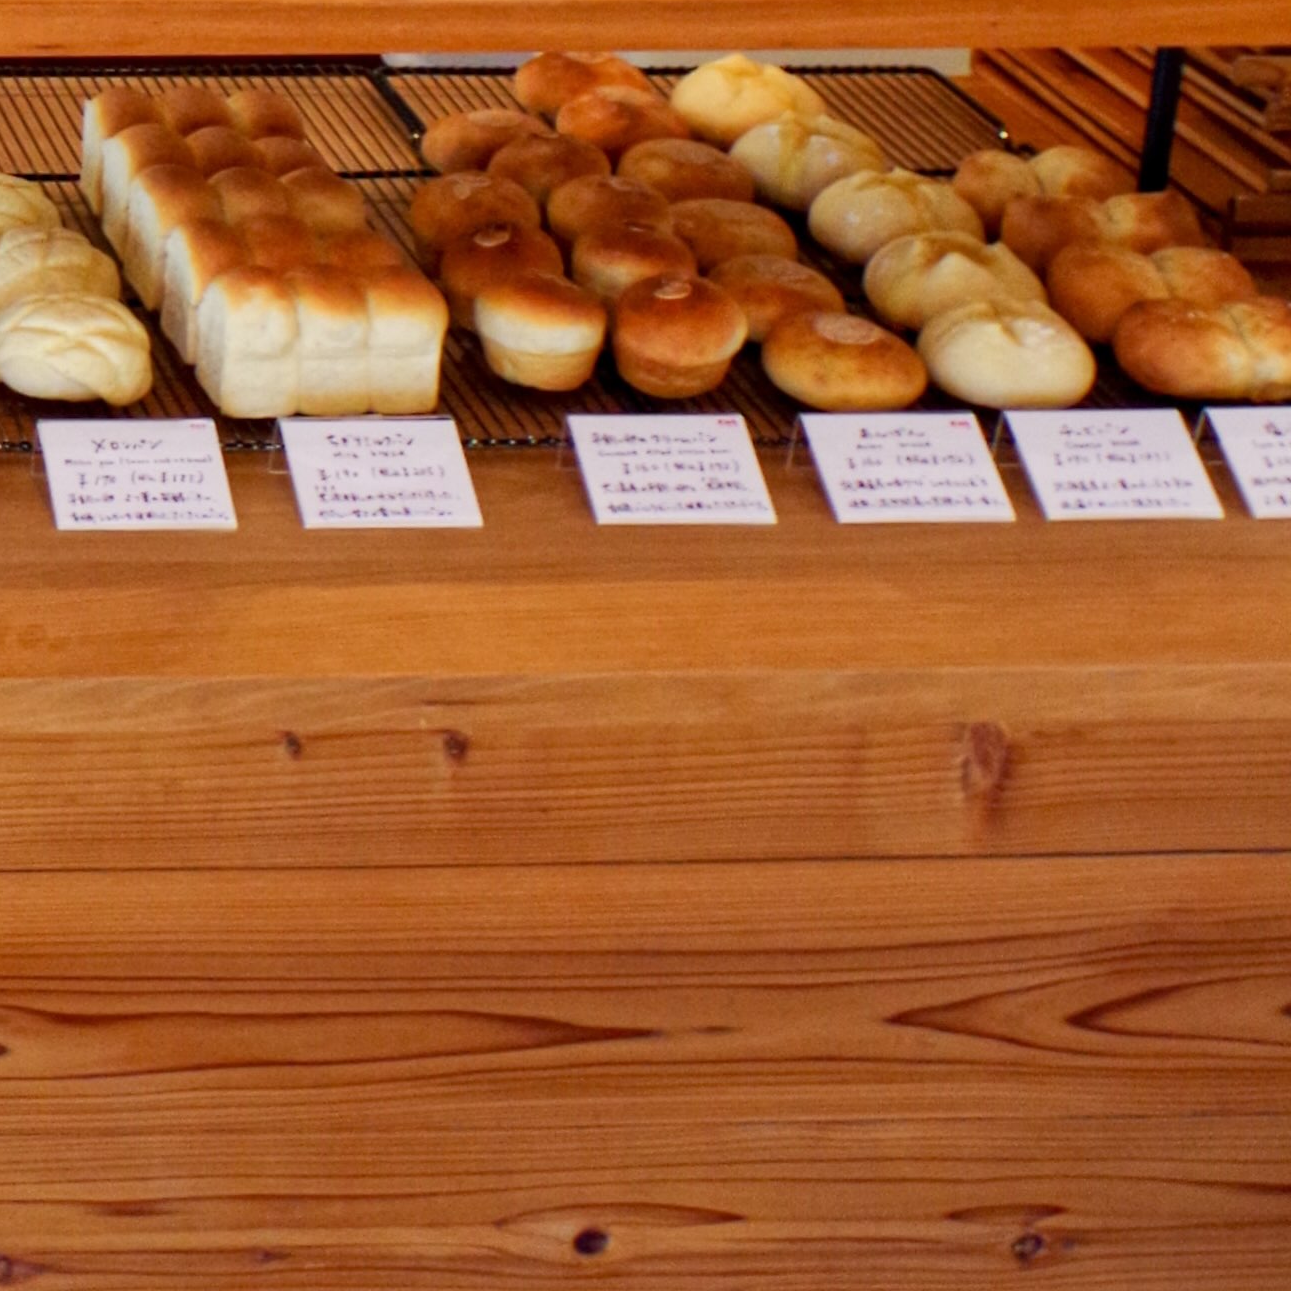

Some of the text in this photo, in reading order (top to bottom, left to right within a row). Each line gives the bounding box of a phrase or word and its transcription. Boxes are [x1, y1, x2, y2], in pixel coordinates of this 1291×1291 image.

[91, 438, 164, 454] メロンパン
